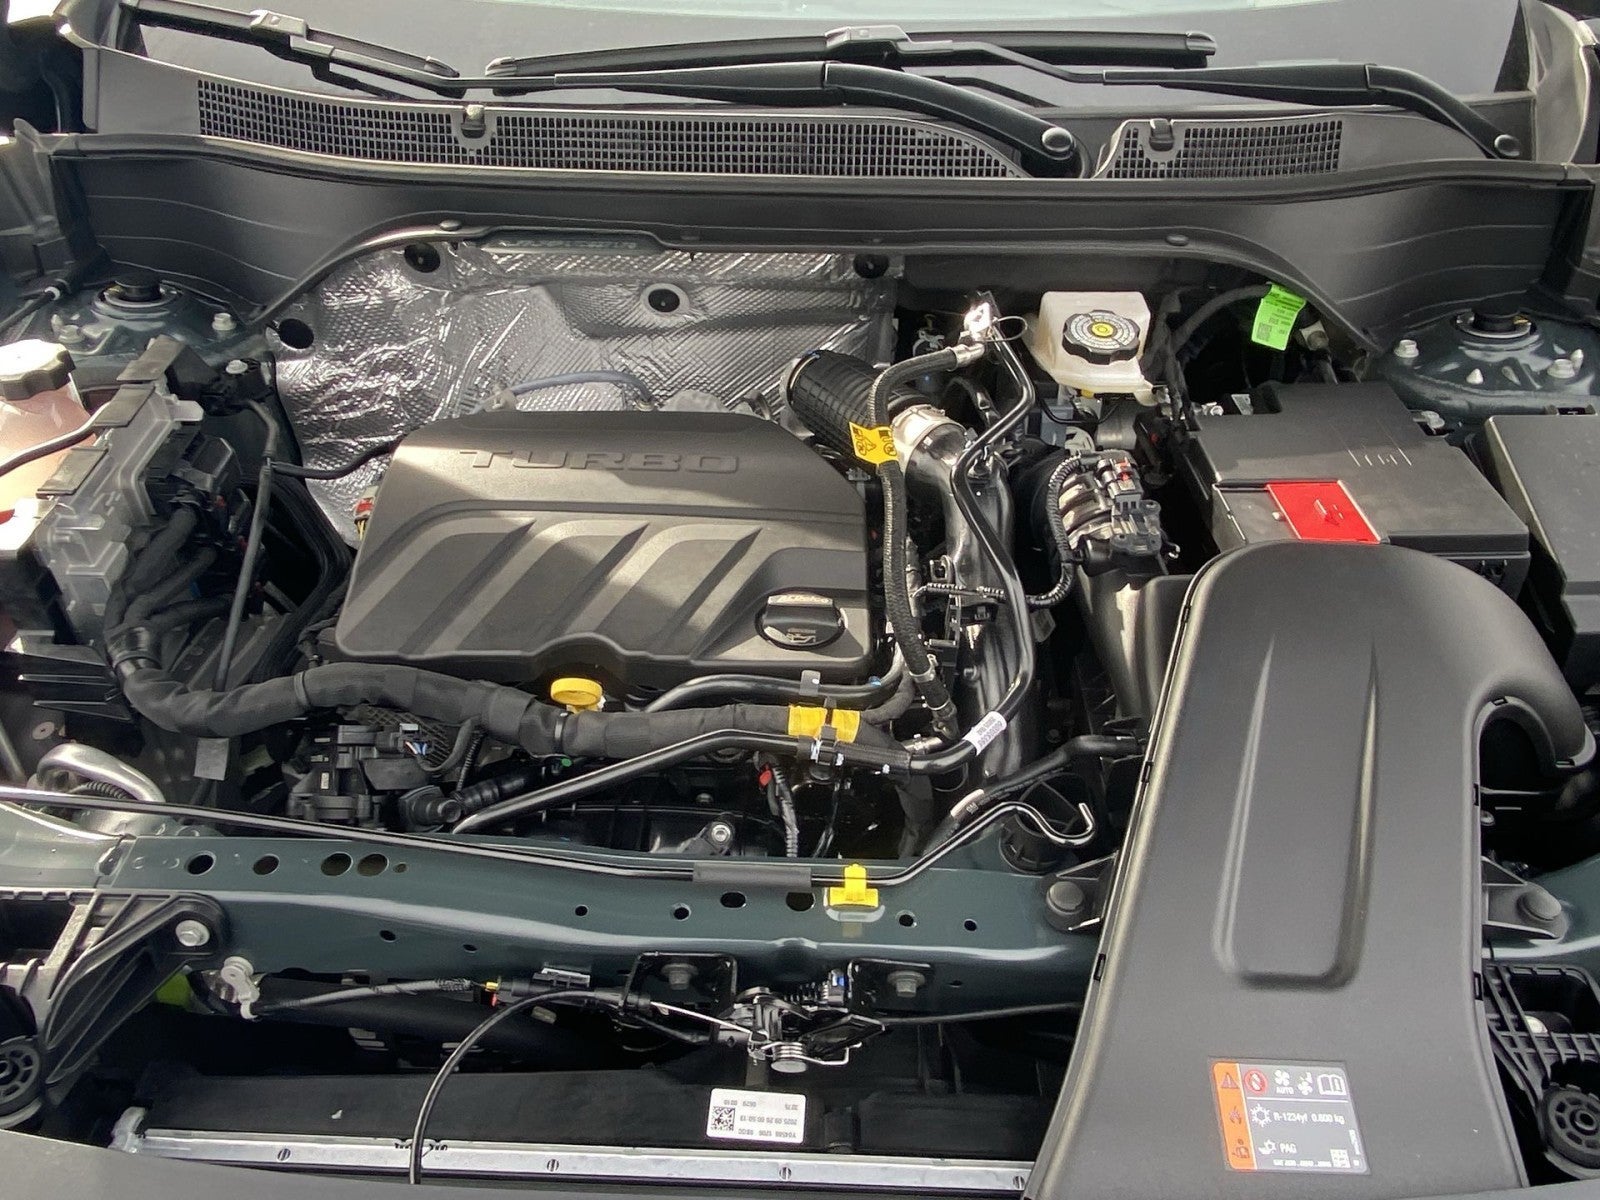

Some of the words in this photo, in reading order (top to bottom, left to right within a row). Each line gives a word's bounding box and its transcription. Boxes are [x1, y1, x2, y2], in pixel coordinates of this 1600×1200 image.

[459, 450, 738, 474] TURBO
[1276, 1087, 1294, 1095] AUTO
[1273, 1111, 1309, 1124] R-1234yf
[1333, 1114, 1345, 1125] kg
[1279, 1142, 1298, 1154] PAG
